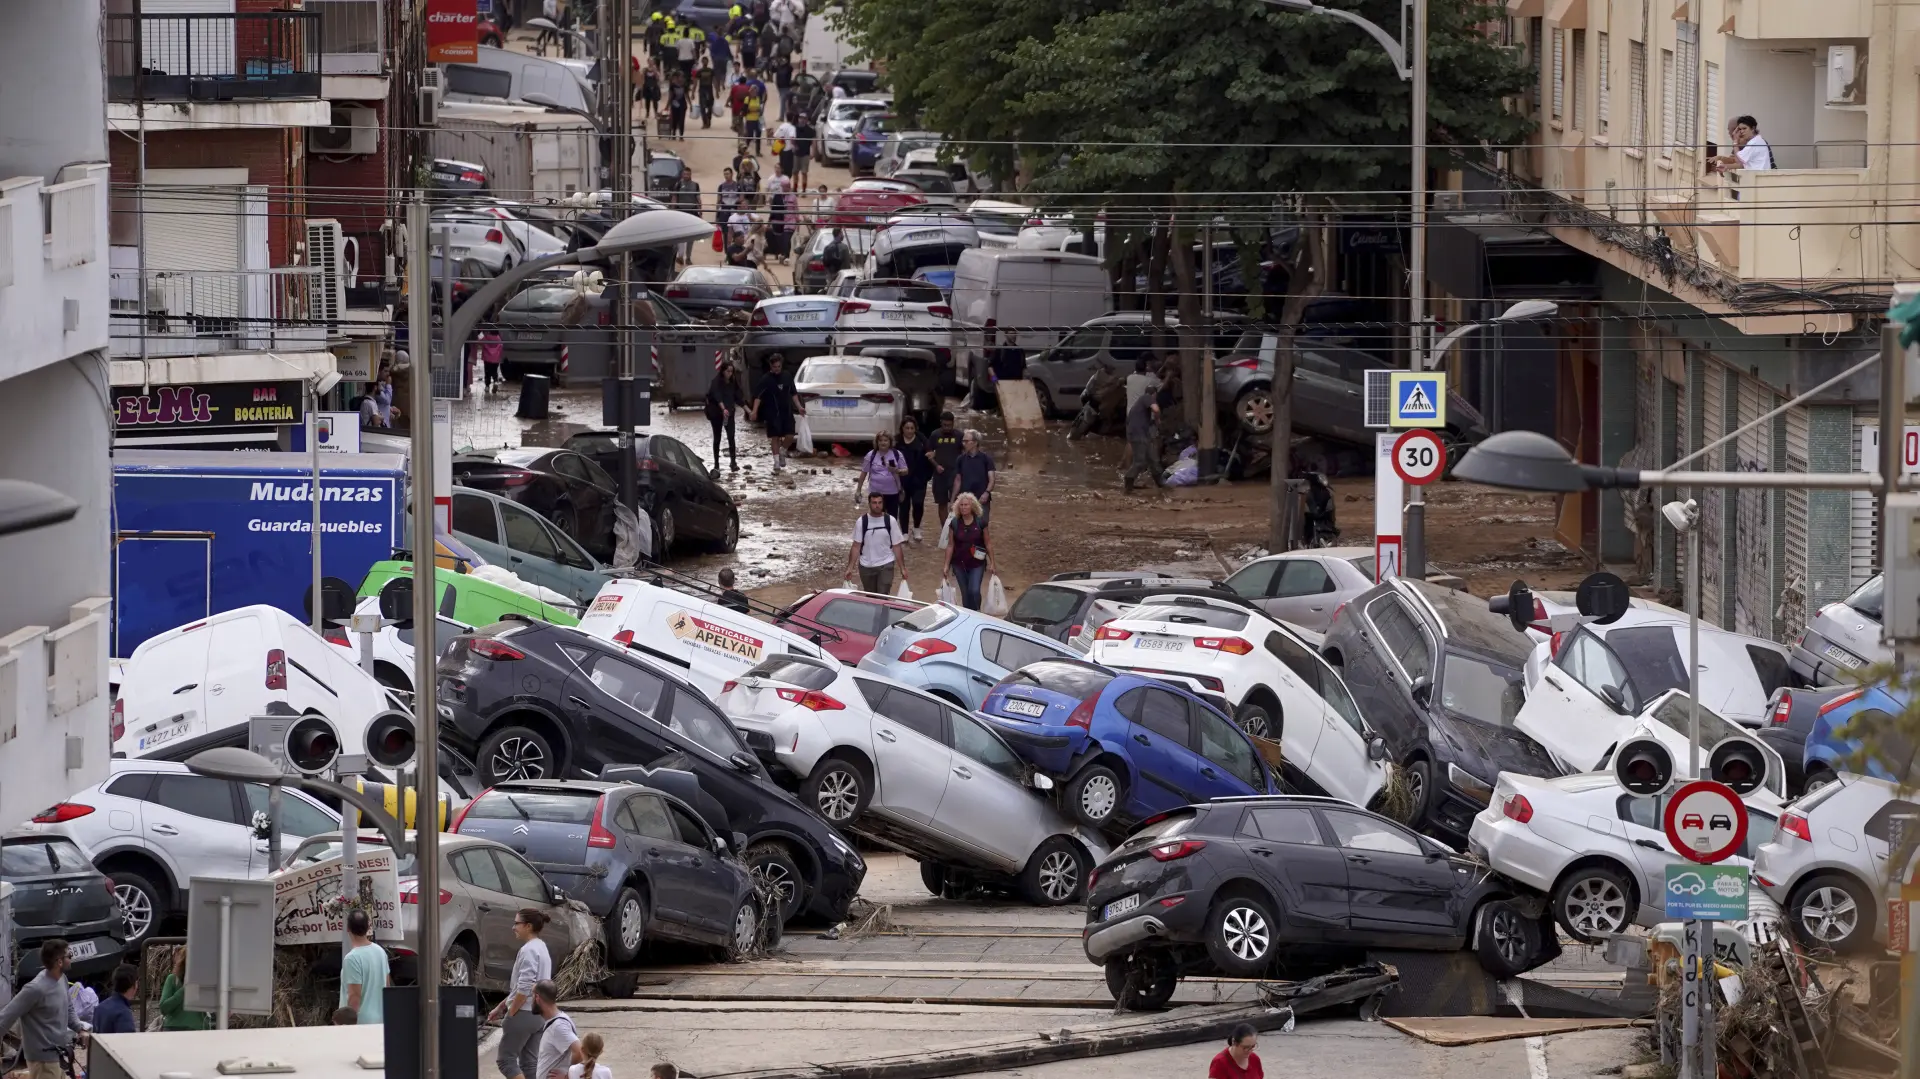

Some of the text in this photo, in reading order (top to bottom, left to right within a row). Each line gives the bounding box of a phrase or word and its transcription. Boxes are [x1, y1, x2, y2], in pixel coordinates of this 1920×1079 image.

[428, 11, 476, 23] charter
[252, 387, 278, 402] BAR
[234, 404, 295, 422] BOCATERÍA
[1405, 447, 1433, 467] 30
[250, 482, 383, 502] Mudanzas
[248, 518, 382, 533] Guardamuebles
[703, 621, 755, 645] VERTICALES
[695, 629, 758, 659] APELYAN
[1827, 646, 1845, 660] 5601
[1009, 699, 1040, 714] 2304 CTL
[145, 723, 189, 745] 4477 LKV
[308, 867, 332, 880] LOS
[334, 857, 390, 872] TNES!!
[1113, 862, 1127, 873] KIA
[46, 887, 83, 896] DACIA
[302, 922, 323, 936] por
[326, 920, 343, 932] las
[79, 943, 94, 955] MVT
